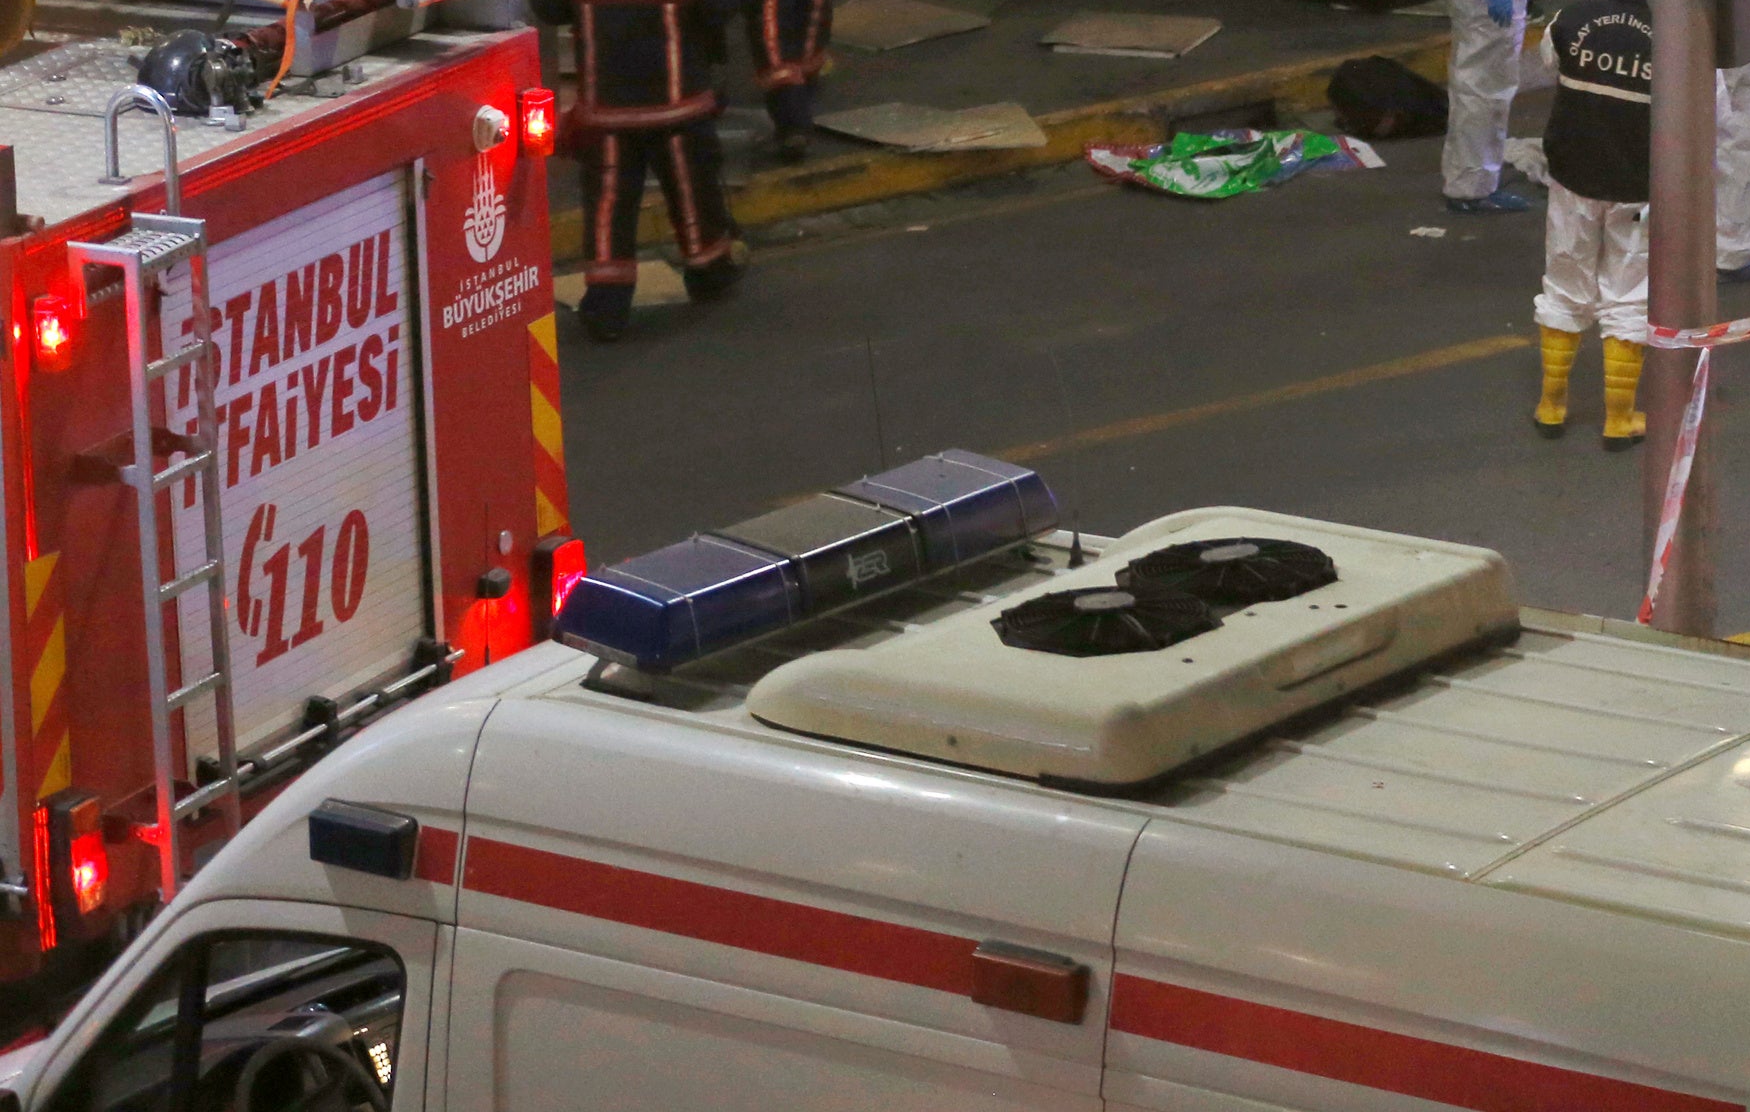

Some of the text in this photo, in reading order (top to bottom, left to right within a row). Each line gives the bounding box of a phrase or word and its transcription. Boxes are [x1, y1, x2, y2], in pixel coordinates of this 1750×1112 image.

[1579, 49, 1652, 80] POLİS
[1593, 13, 1626, 27] YERİ
[178, 227, 399, 409] İSTANBUL
[443, 265, 539, 328] BÜYÜKŞEHİR
[183, 323, 399, 510] İFAİYESİ
[256, 509, 369, 668] 110
